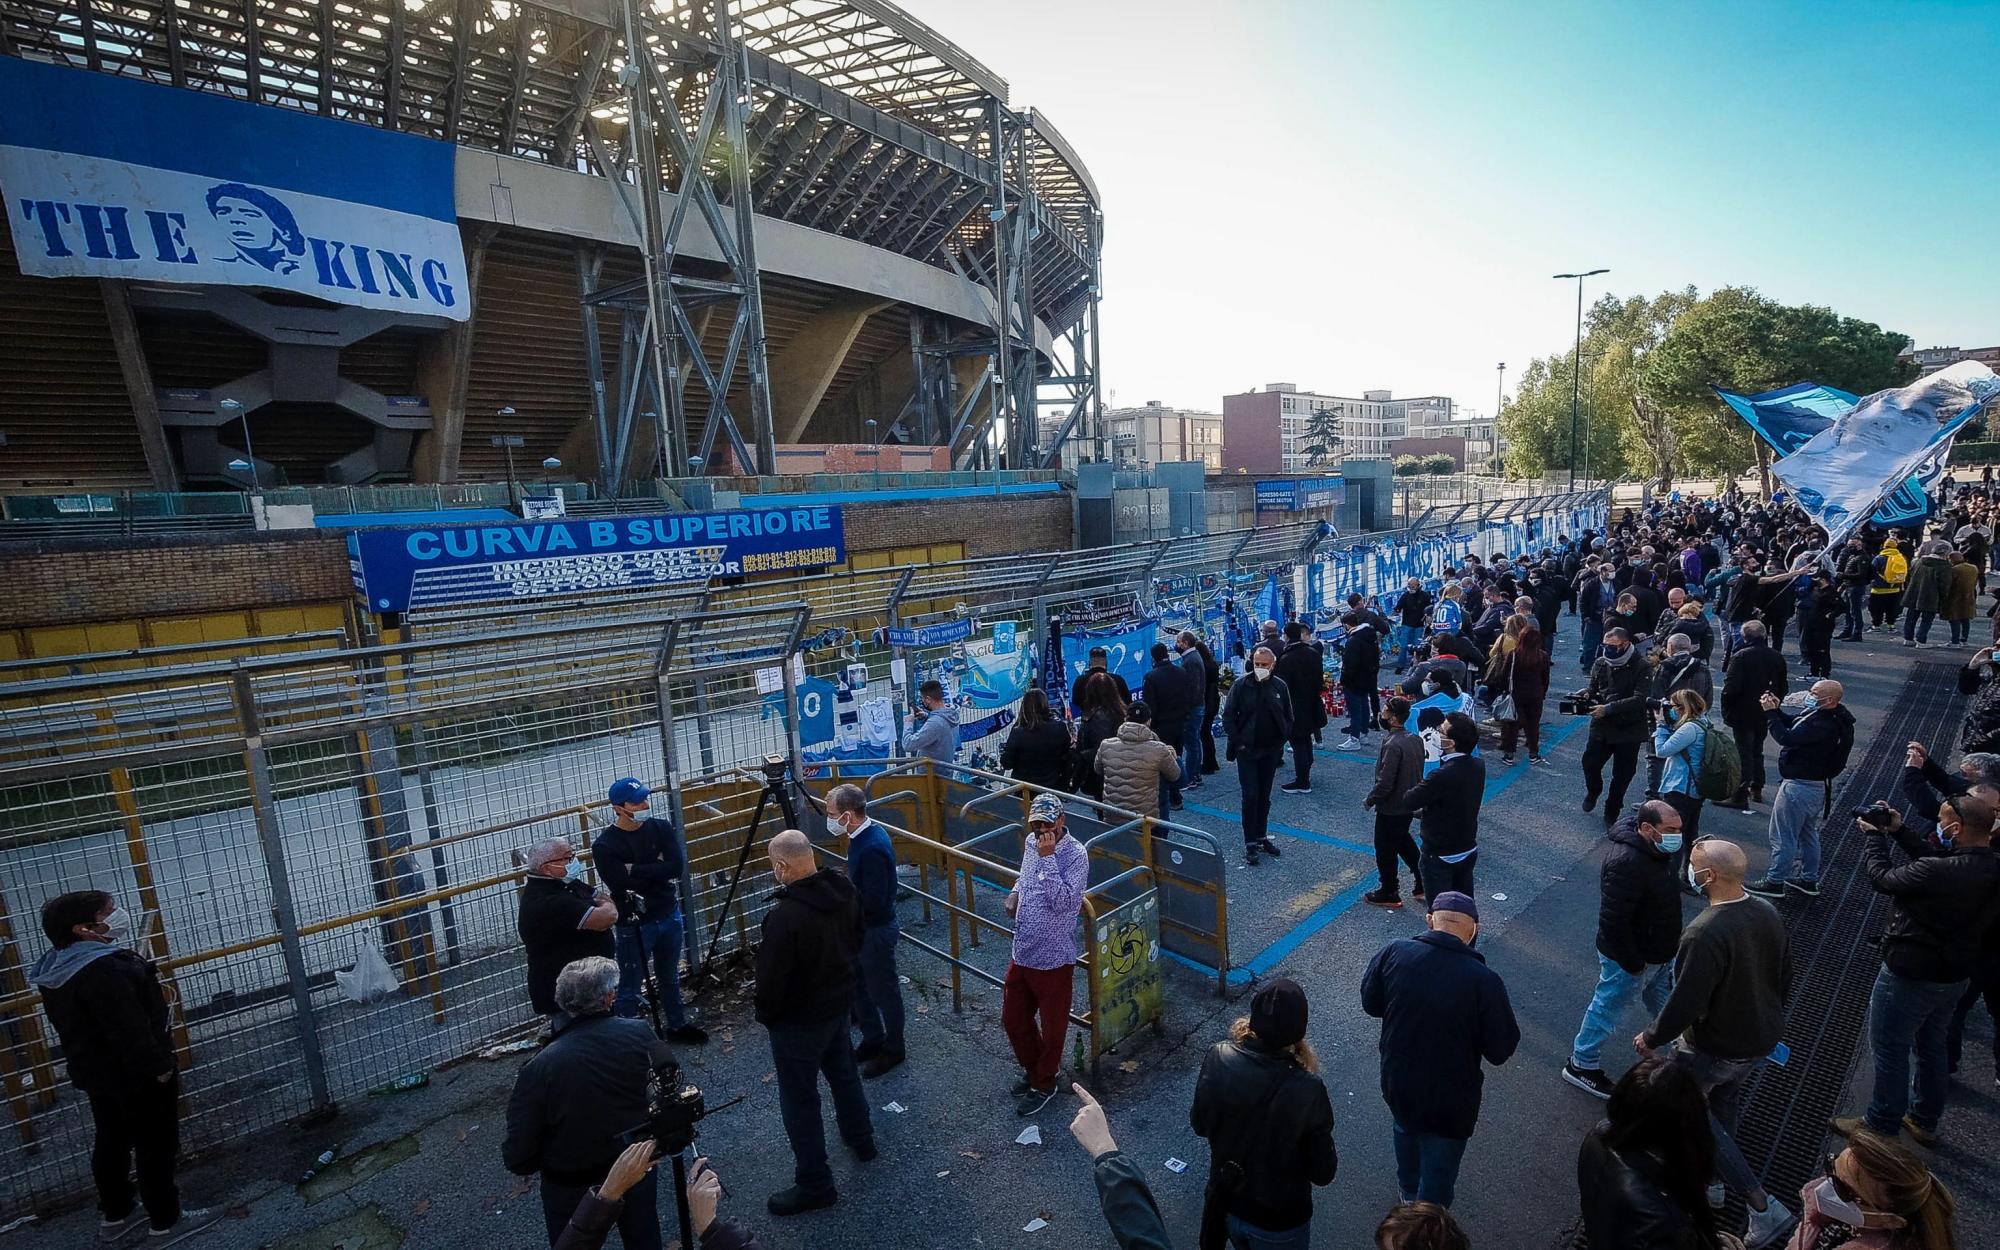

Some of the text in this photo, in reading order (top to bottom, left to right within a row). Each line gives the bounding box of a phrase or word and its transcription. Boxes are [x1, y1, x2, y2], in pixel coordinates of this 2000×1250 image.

[20, 199, 457, 308] THE KING
[406, 524, 576, 560] CURVA
[588, 521, 618, 547] B
[512, 561, 740, 594] SETTORE SECTOR
[1436, 608, 1447, 623] 10
